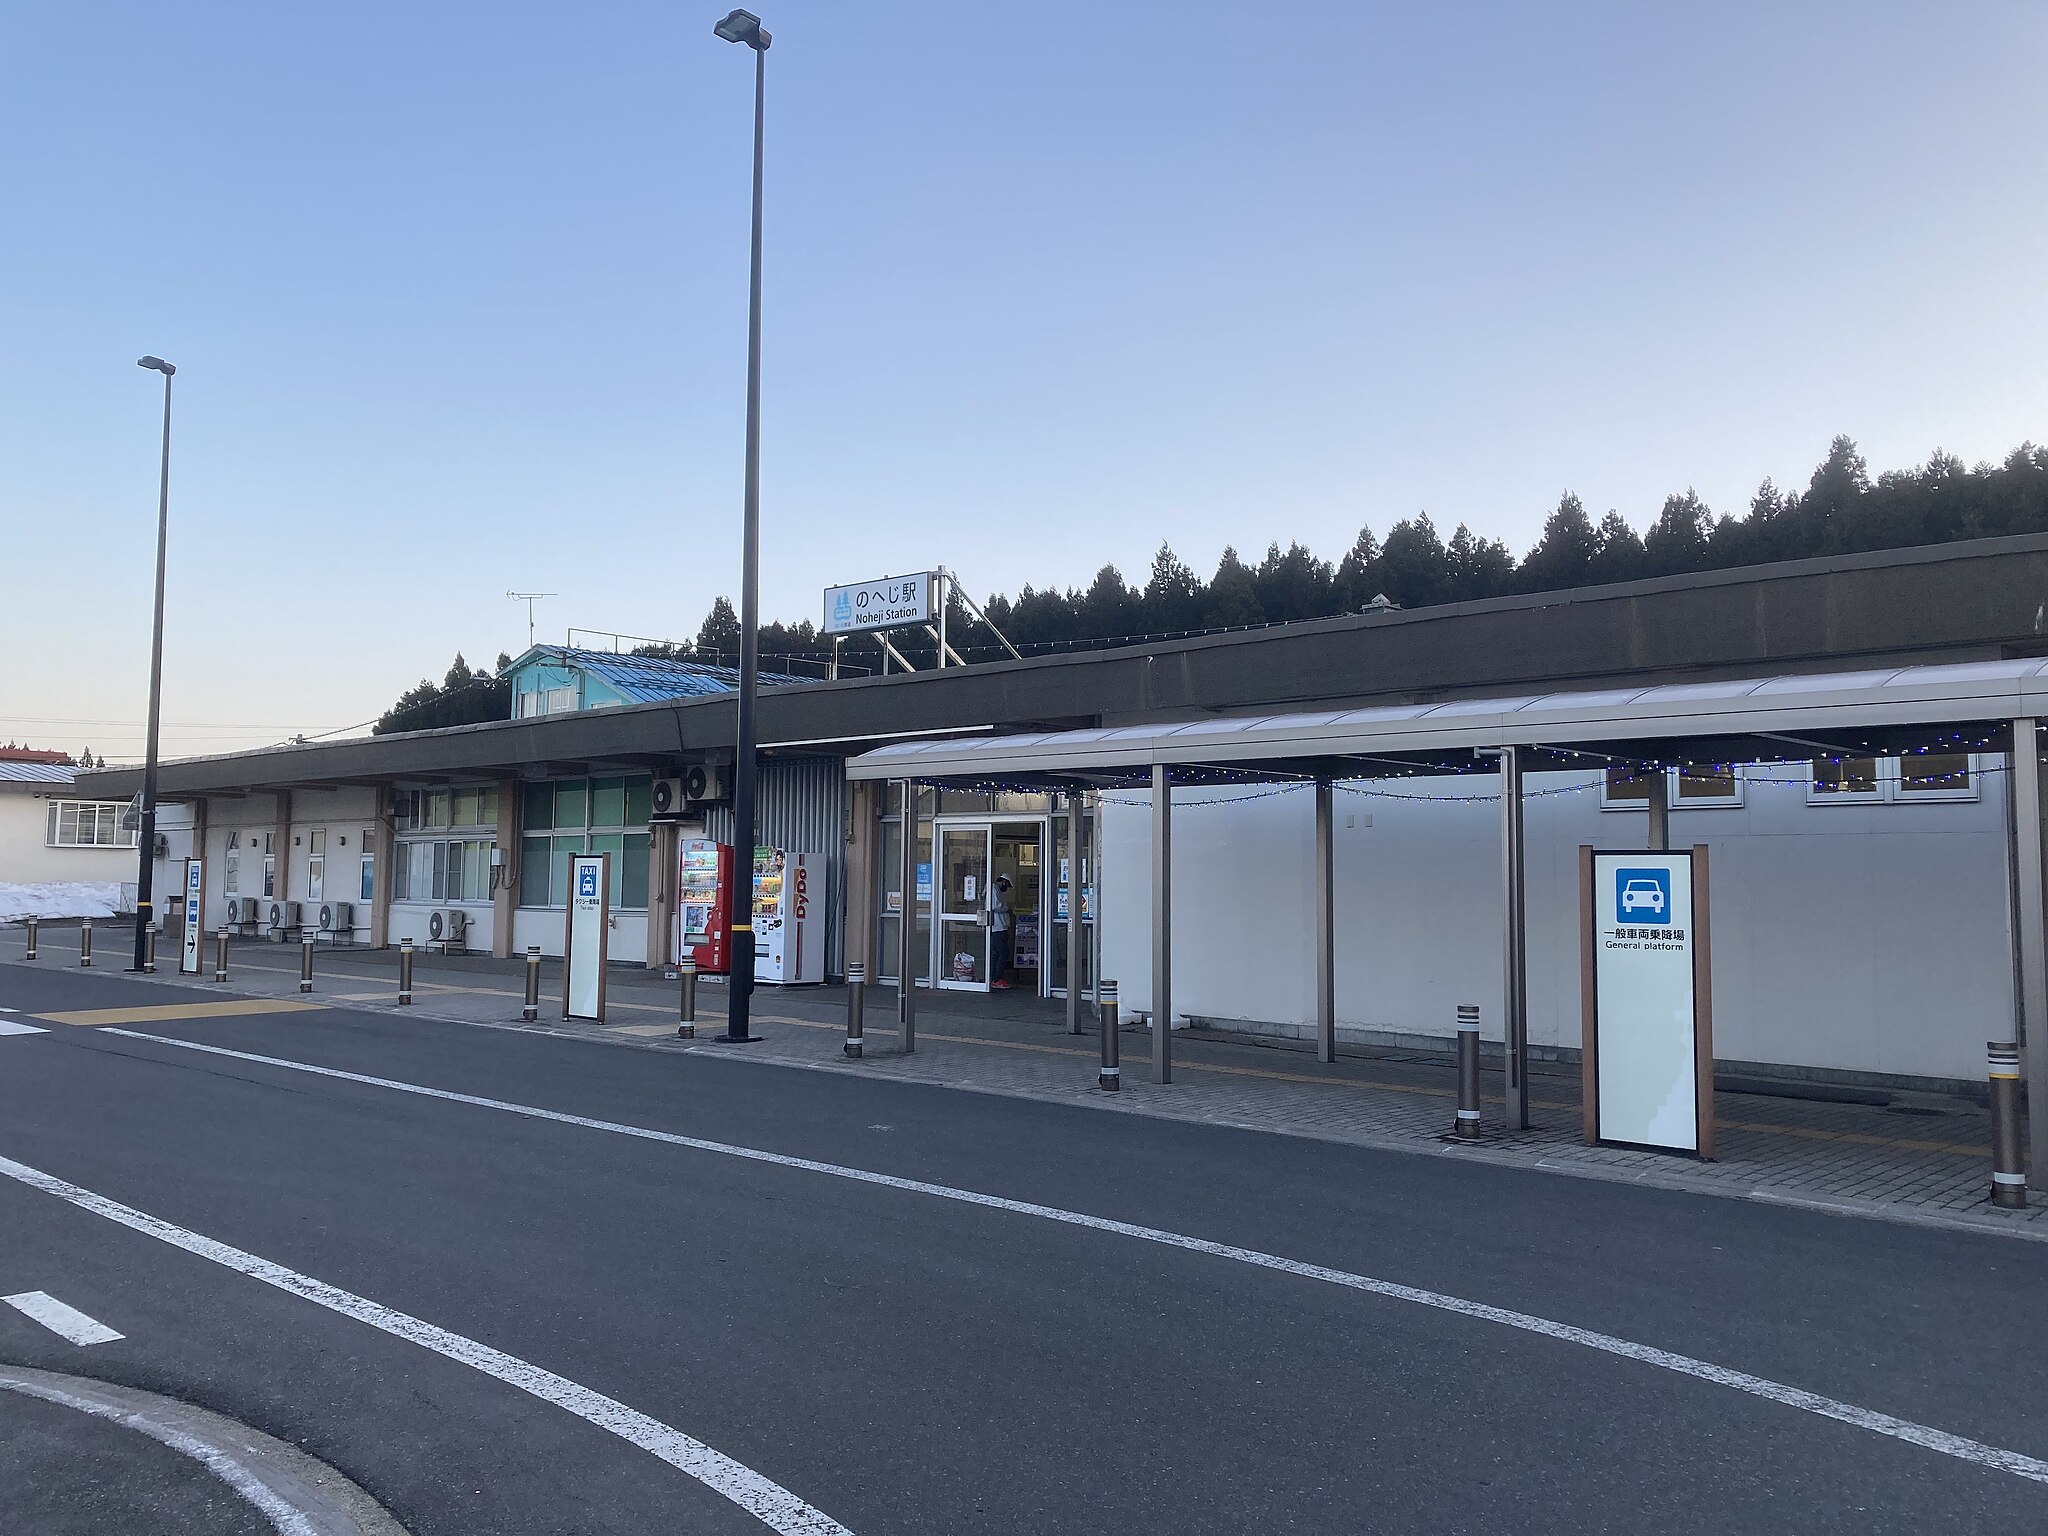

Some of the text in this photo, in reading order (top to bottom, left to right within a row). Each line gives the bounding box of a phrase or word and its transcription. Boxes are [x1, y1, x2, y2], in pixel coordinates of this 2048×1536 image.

[856, 581, 916, 608] のへじ駅
[855, 610, 884, 627] Noheji
[886, 607, 917, 620] Station
[581, 867, 596, 875] TAXI
[796, 868, 809, 914] DyDo
[1604, 928, 1685, 941] 一般車両乗降場
[1605, 941, 1684, 951] General platform
